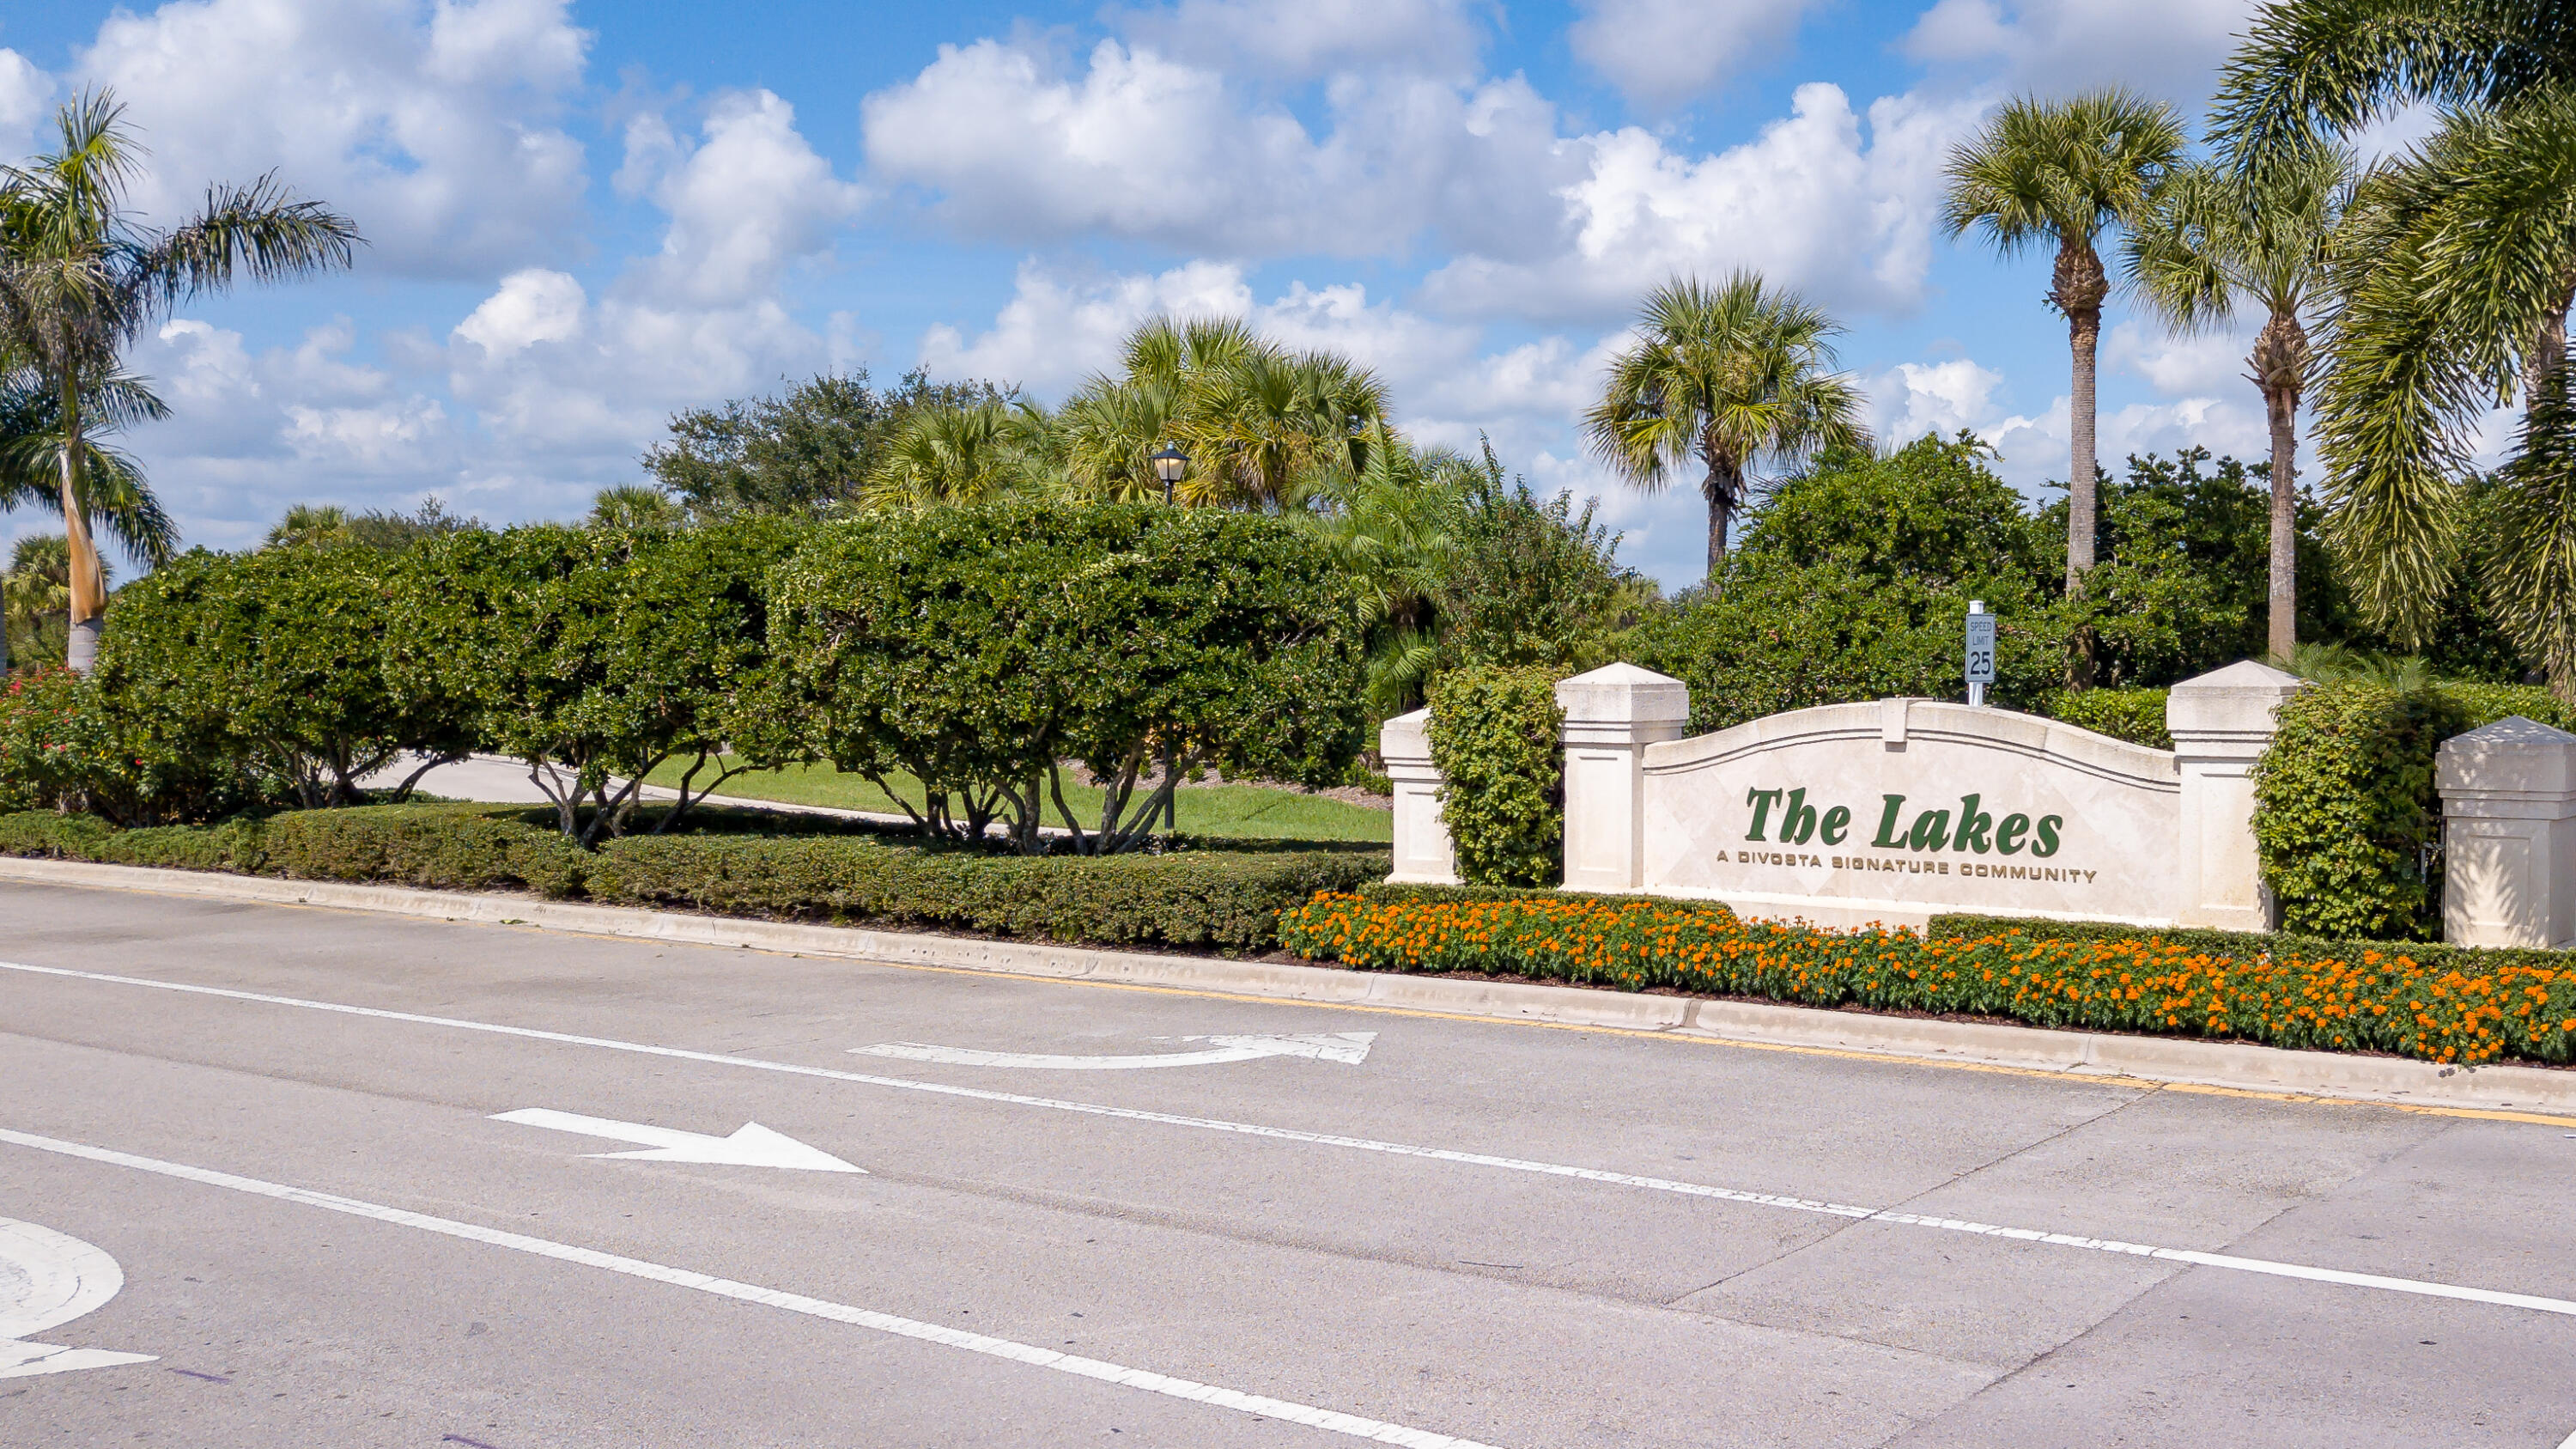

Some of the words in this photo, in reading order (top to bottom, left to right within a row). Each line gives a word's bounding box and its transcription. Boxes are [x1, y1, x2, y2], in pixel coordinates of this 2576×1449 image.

[1970, 622, 1992, 632] SPEED
[1972, 636, 1990, 646] LIMIT
[1971, 651, 1991, 675] 25
[1745, 787, 1850, 845] The
[1870, 793, 2063, 857] Lakes
[1717, 850, 1728, 862] A
[1738, 851, 1822, 868] DIVOSTA
[1832, 856, 1949, 874] SIGNATURE
[1960, 863, 2097, 884] COMMUNITY
